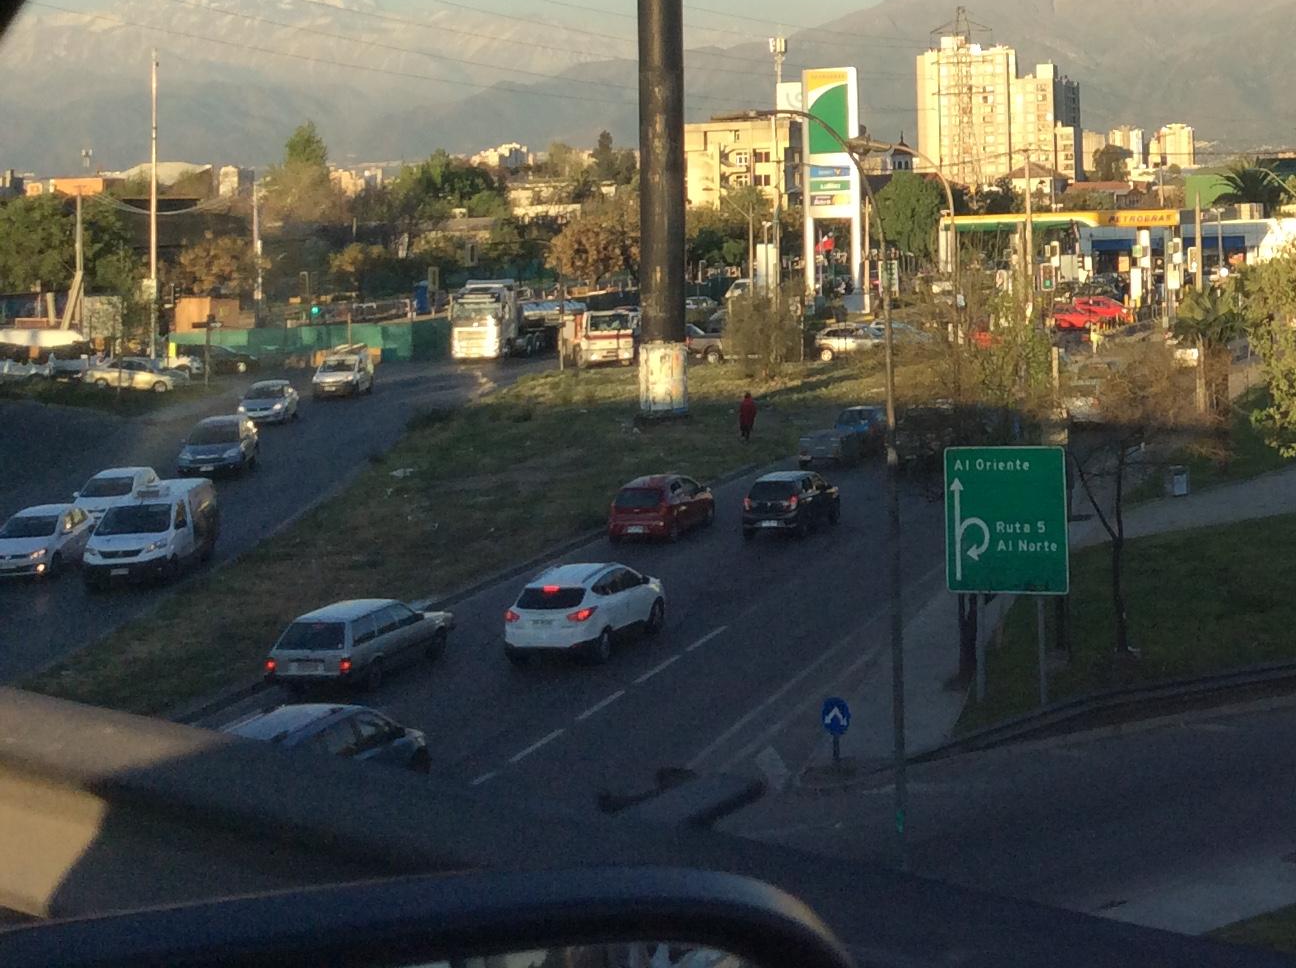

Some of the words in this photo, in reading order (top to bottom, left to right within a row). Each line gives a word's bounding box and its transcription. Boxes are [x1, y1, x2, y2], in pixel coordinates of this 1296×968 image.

[954, 459, 969, 471] Al
[976, 458, 1030, 471] Oriente
[996, 521, 1030, 533] Ruta
[1037, 521, 1046, 533] 5
[997, 540, 1012, 552] Al
[1018, 540, 1058, 552] Norte
